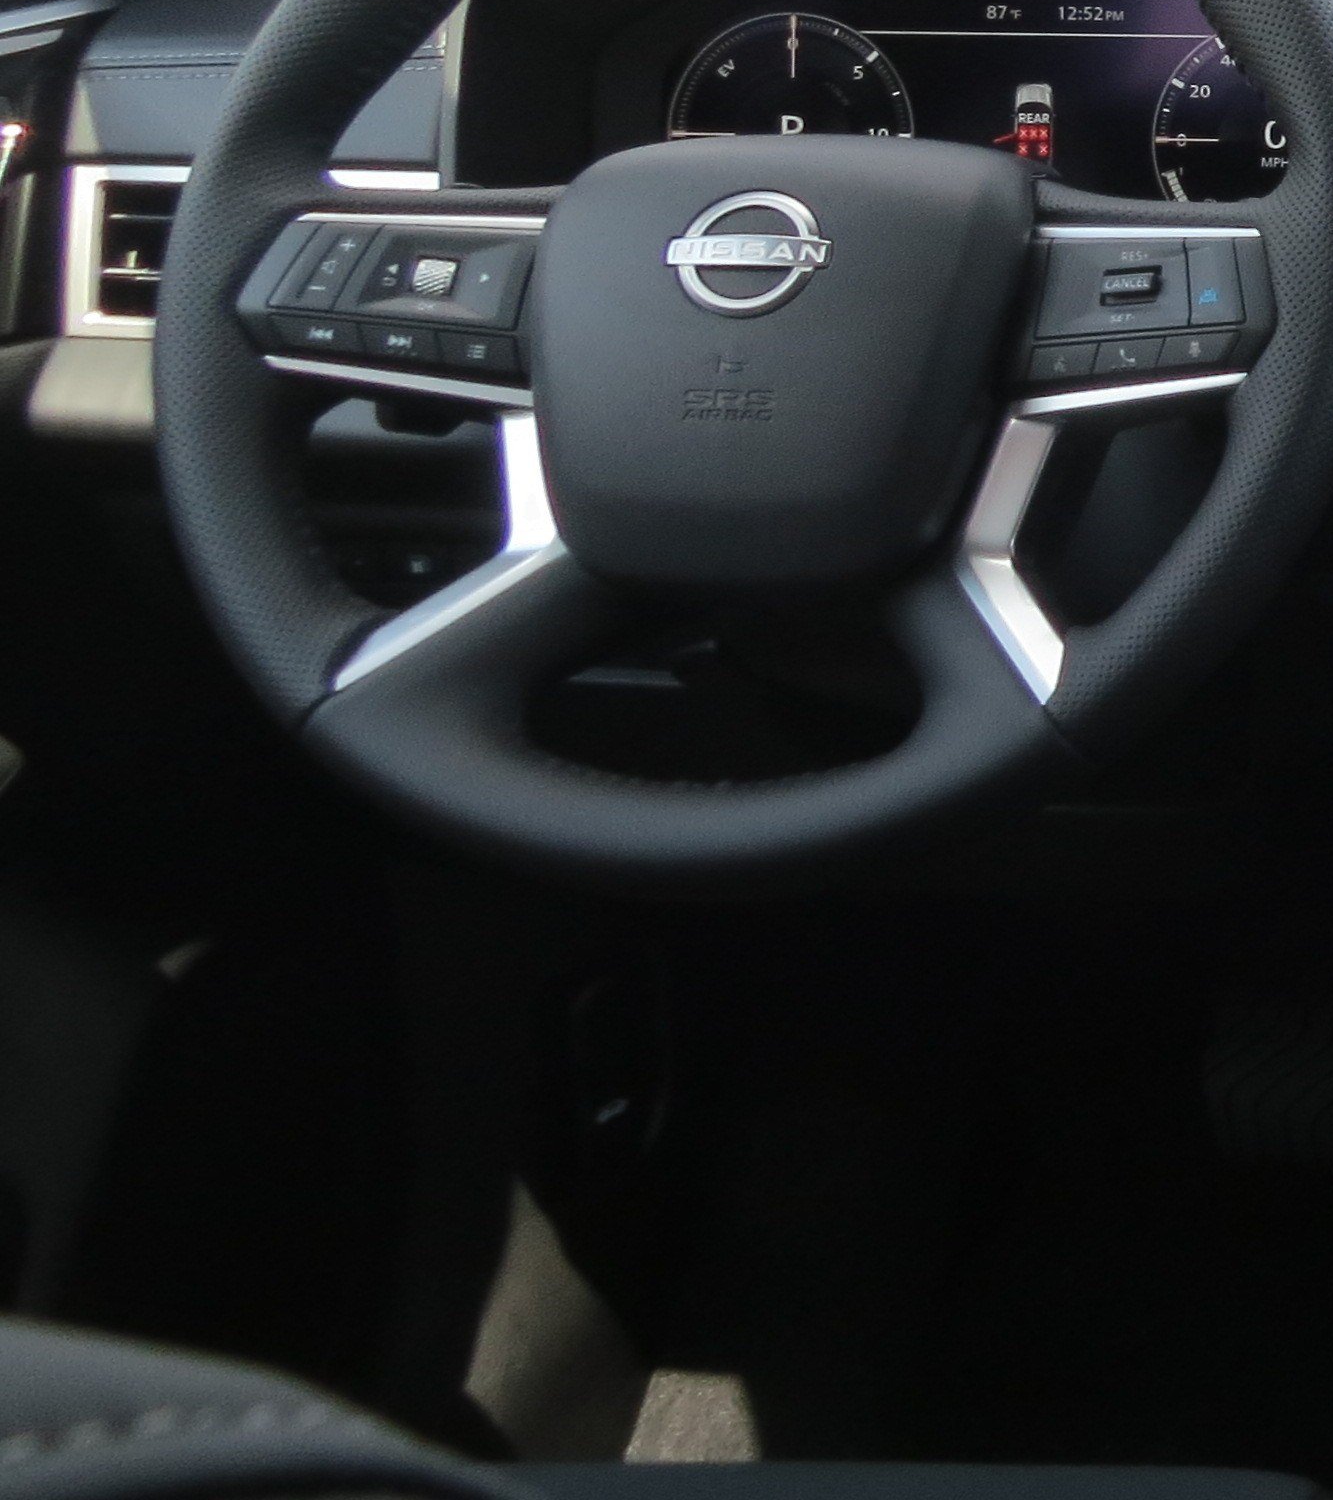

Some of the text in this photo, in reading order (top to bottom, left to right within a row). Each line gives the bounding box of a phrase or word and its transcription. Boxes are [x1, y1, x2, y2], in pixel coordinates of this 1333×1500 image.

[852, 66, 865, 80] 5
[1189, 85, 1212, 99] 20
[1018, 112, 1050, 124] REAR
[668, 241, 829, 264] NISSAN
[1104, 276, 1151, 290] CANCEL
[682, 388, 775, 406] SRS
[682, 408, 773, 422] AIRBAG
